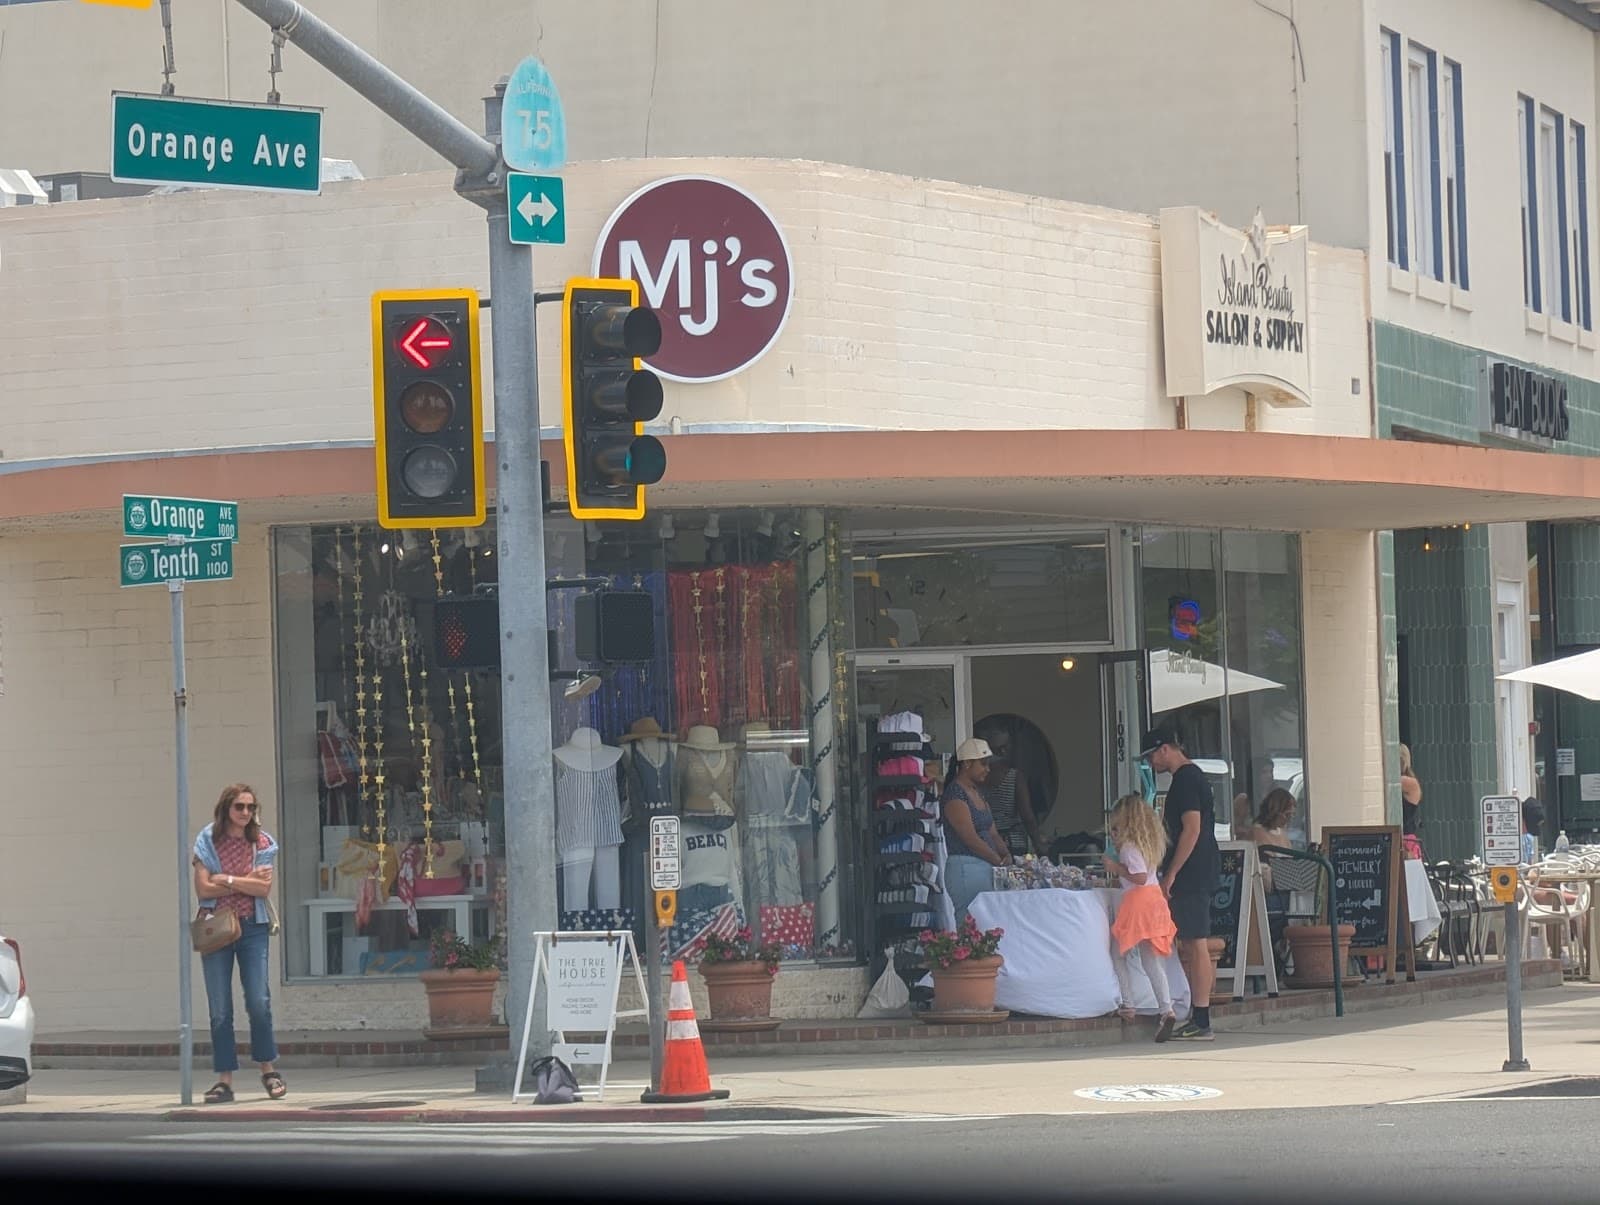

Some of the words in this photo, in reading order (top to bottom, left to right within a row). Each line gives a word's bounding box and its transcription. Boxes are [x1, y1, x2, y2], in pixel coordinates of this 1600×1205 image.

[128, 123, 234, 172] Orange
[253, 134, 307, 169] Ave
[515, 110, 552, 149] 75
[619, 236, 777, 336] Mj's
[1218, 253, 1259, 309] Island
[1256, 262, 1294, 322] Beauty
[1206, 309, 1249, 346] SALON
[1253, 315, 1262, 348] &
[1266, 317, 1304, 353] SUPPLY
[1494, 363, 1528, 428] BAY
[1526, 371, 1569, 441] BOOKS
[150, 499, 205, 537] Orange
[220, 507, 233, 520] AVE
[218, 523, 235, 537] 1000
[151, 547, 199, 578] Tenth
[211, 543, 223, 556] ST
[206, 561, 228, 575] 1100
[1337, 860, 1382, 875] JEWELRY
[559, 958, 577, 967] THE
[582, 958, 606, 967] TRUE
[560, 968, 606, 979] HOUSE
